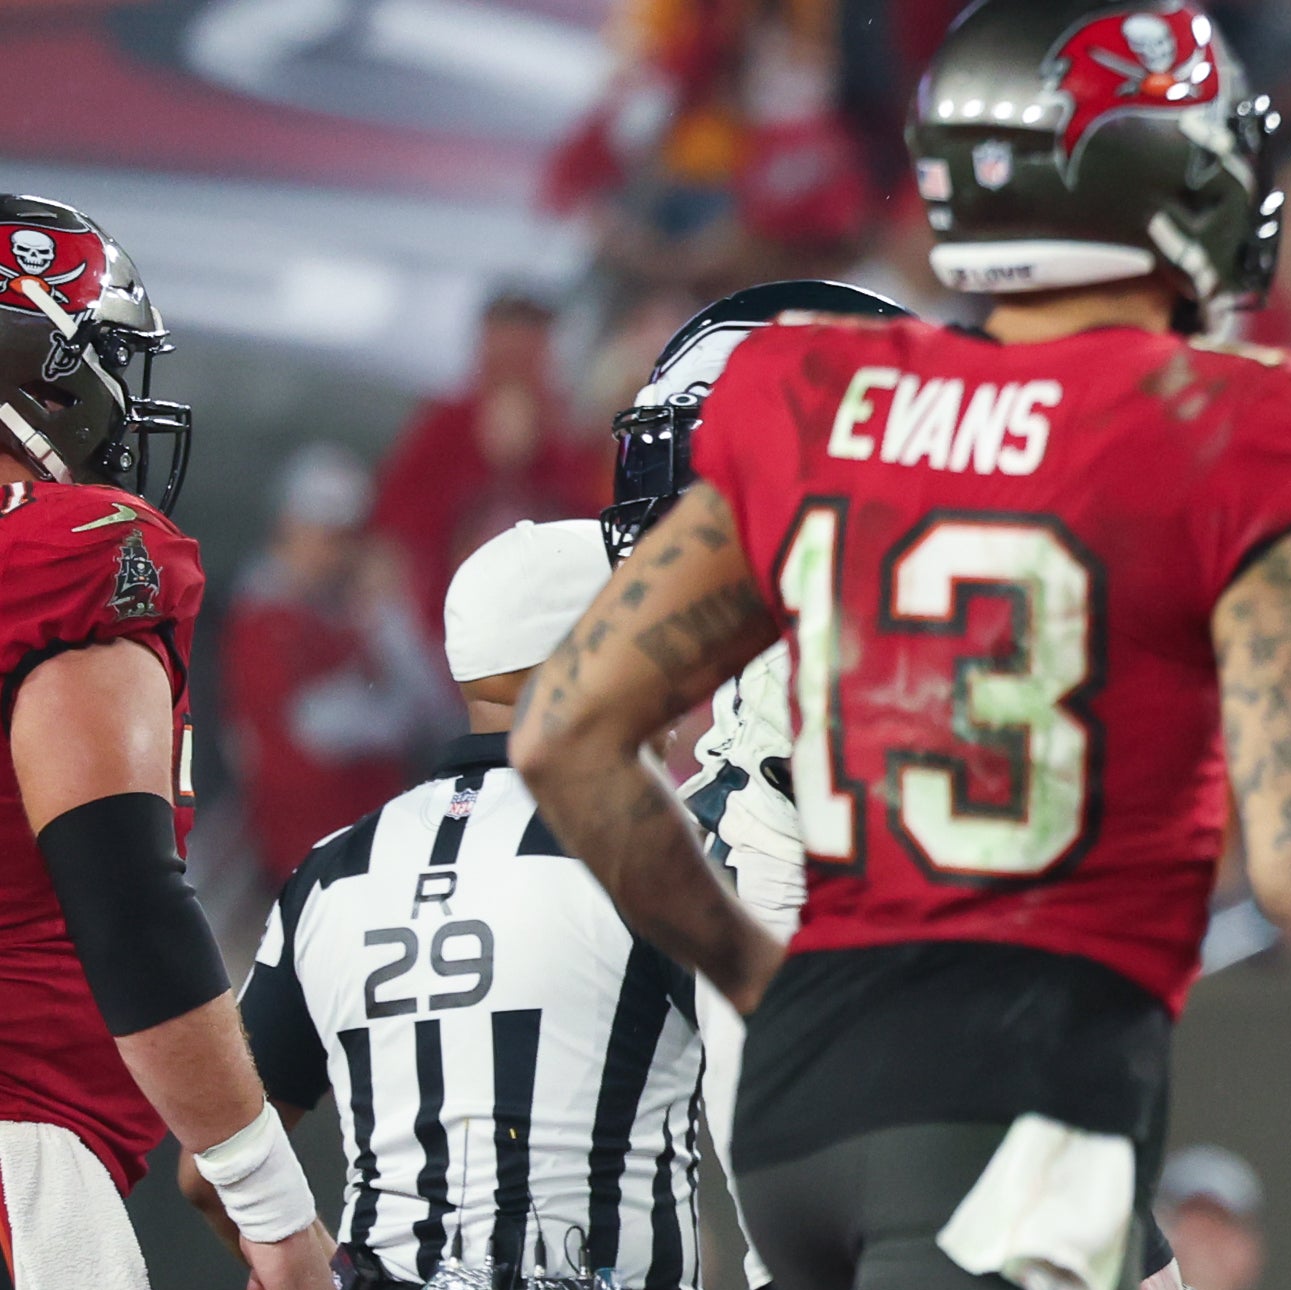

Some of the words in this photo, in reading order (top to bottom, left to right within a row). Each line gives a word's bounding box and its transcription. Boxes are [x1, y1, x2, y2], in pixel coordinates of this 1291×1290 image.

[826, 365, 1064, 477] EVANS
[772, 500, 1108, 888] 13
[410, 871, 458, 919] R
[364, 919, 494, 1019] 29
